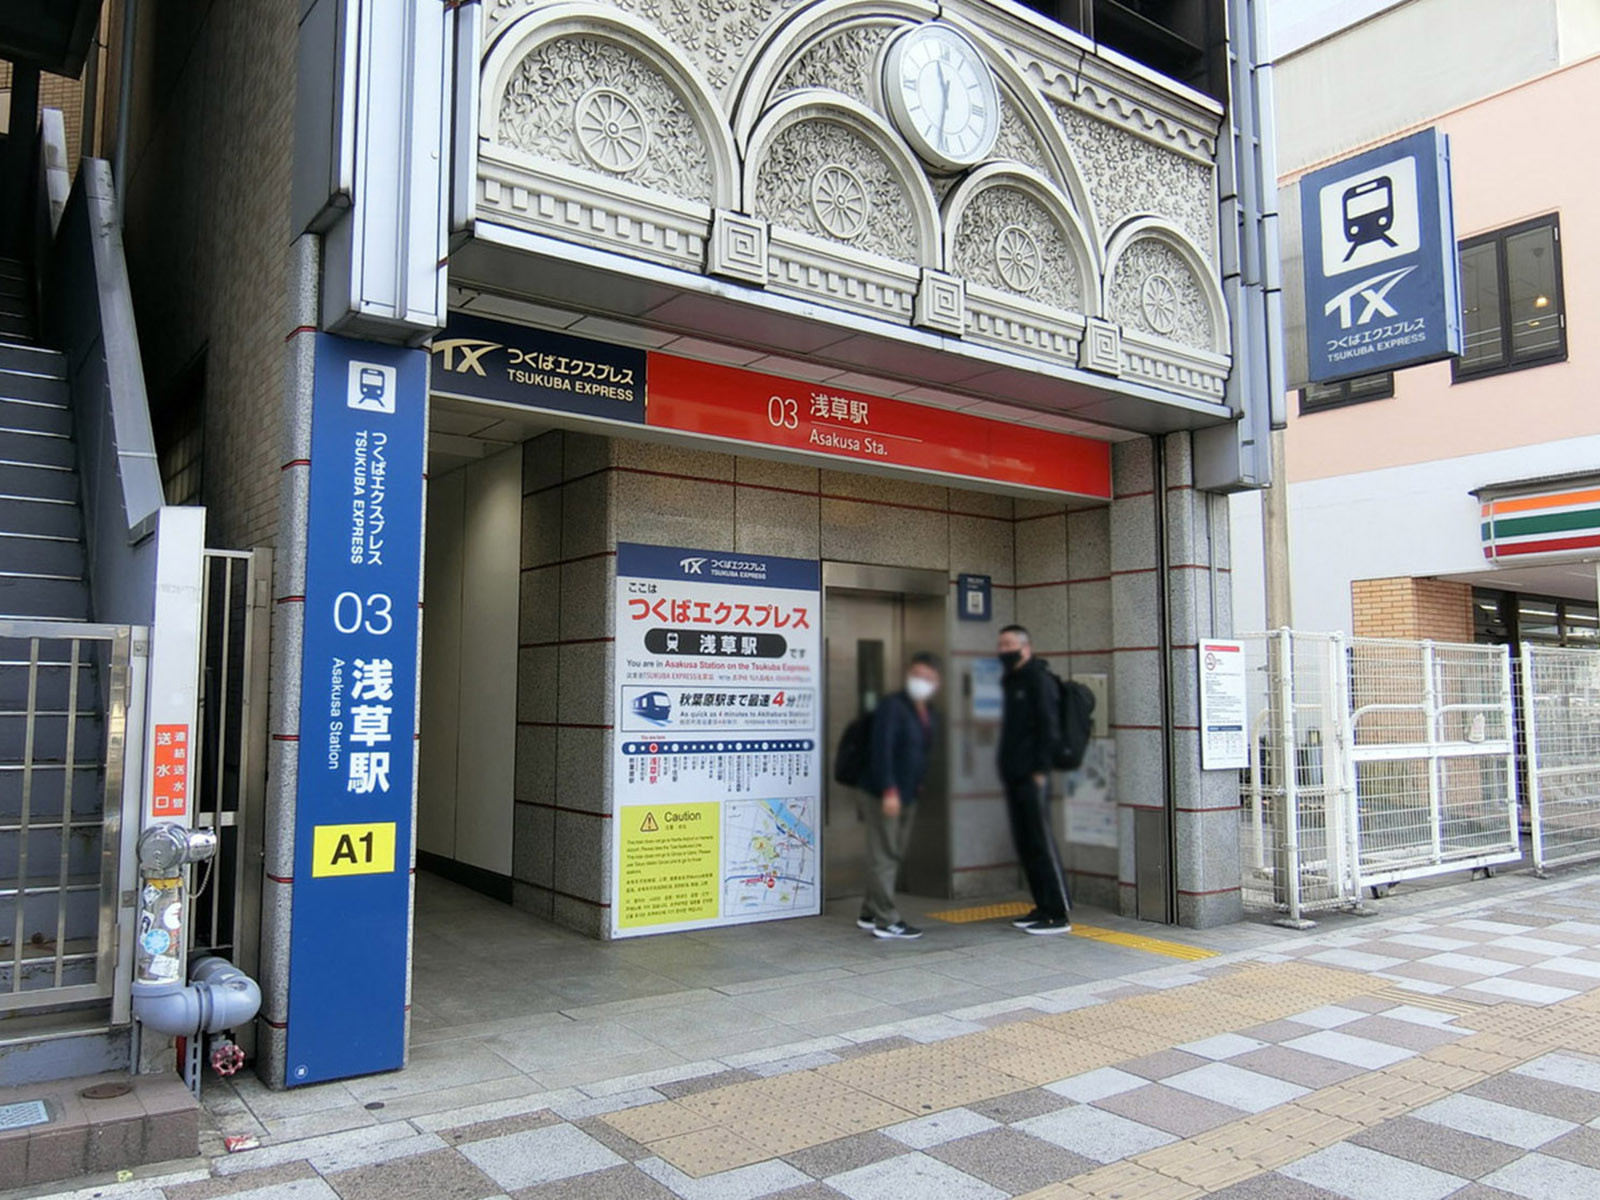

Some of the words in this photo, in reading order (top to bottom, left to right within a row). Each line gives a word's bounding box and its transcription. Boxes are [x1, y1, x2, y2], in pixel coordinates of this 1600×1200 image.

[1325, 265, 1419, 329] TX
[1327, 317, 1426, 351] つくばエクスプレス
[1328, 345, 1375, 362] TSUKUBA
[1377, 332, 1426, 351] EXPRESS
[432, 338, 504, 377] TX
[507, 348, 634, 385] つくばエクスプレス
[507, 368, 572, 391] TSUKUBA
[575, 381, 634, 402] EXPRESS
[768, 396, 799, 429] 03
[809, 392, 869, 425] 浅草駅
[809, 429, 861, 451] Asakusa
[864, 437, 888, 456] Sta.
[354, 430, 368, 496] TSUKUBA
[367, 432, 387, 565] つくばエクスプレス
[351, 500, 365, 564] EXPRESS
[680, 557, 709, 574] TX
[628, 582, 658, 594] ここは
[333, 591, 393, 635] 03
[628, 598, 810, 629] つくばエクスプレス
[699, 633, 757, 655] 浅草駅
[789, 648, 806, 659] です
[627, 659, 641, 668] You
[656, 659, 663, 667] in
[664, 660, 698, 669] Asakusa
[699, 660, 726, 669] Station
[738, 662, 749, 670] the
[751, 662, 780, 671] Tsukuba
[329, 657, 346, 717] Asakusa
[347, 658, 394, 794] 浅草駅
[328, 720, 343, 770] Station
[156, 731, 172, 809] 送水口
[664, 810, 702, 822] Caution
[330, 832, 374, 865] A1
